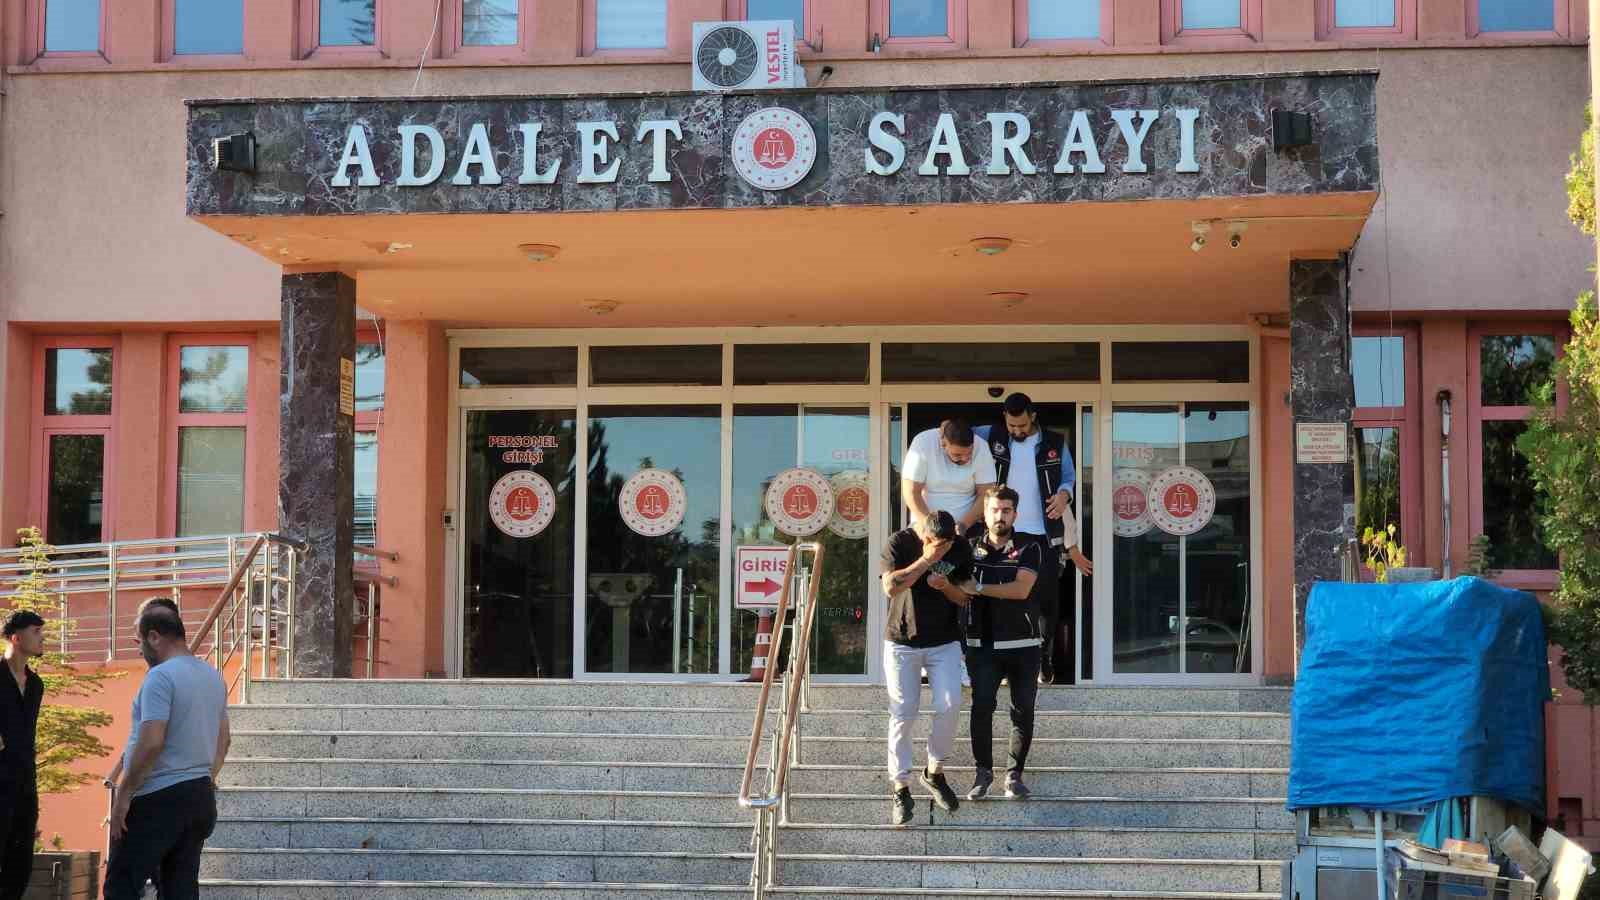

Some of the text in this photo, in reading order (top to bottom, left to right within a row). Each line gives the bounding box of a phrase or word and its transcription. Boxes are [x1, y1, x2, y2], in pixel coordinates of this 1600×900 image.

[766, 27, 780, 84] VESTEL
[331, 119, 684, 188] ADALET
[864, 108, 1200, 176] SARAYI
[488, 435, 559, 448] PERSONEL
[742, 557, 788, 574] GİRİŞ
